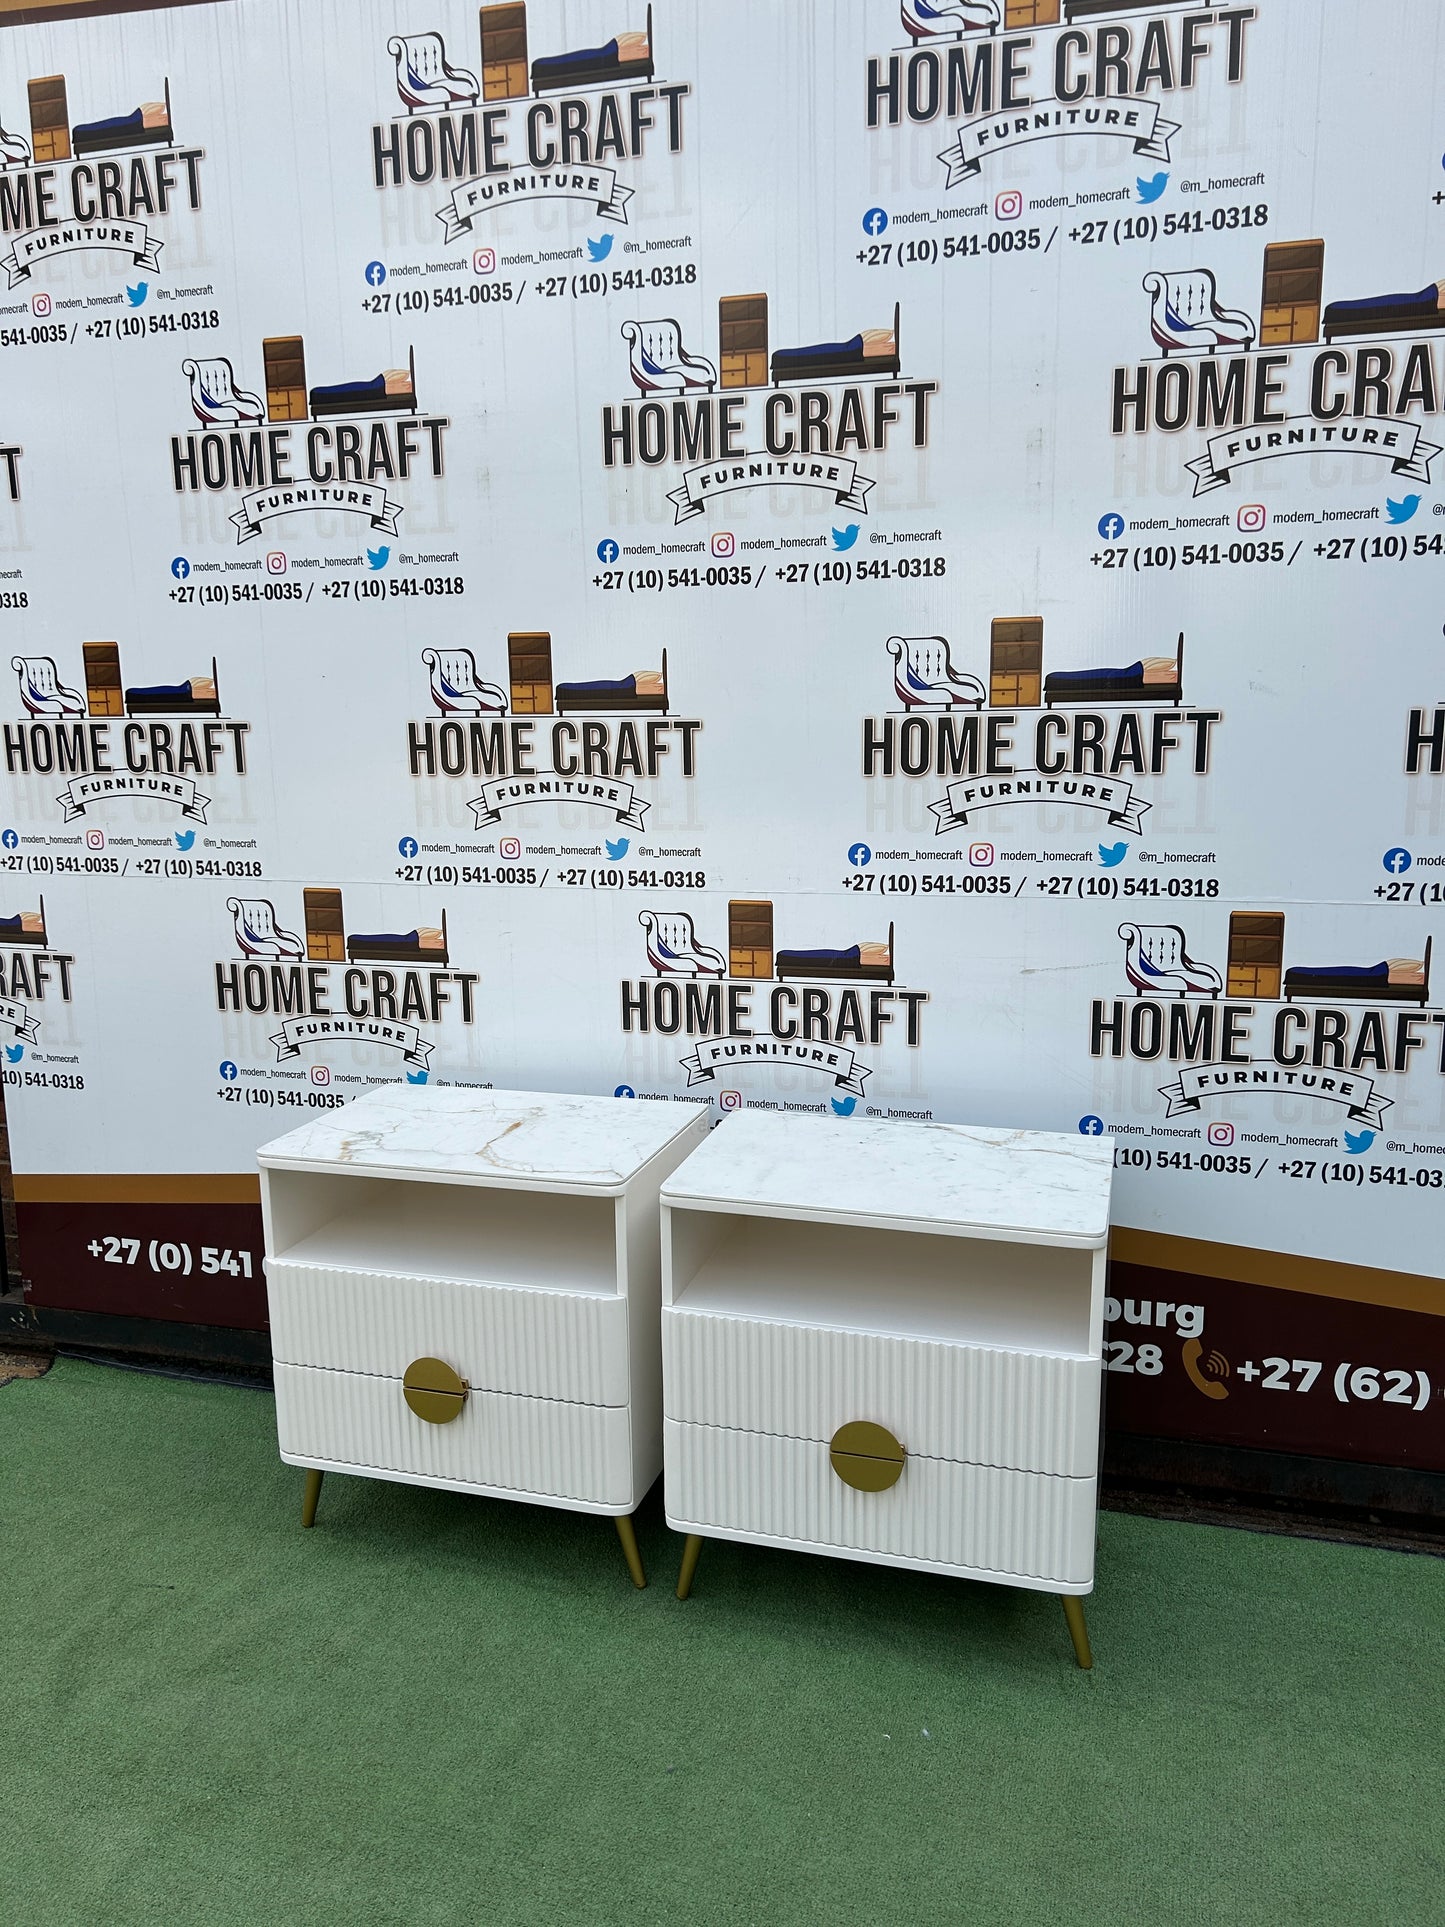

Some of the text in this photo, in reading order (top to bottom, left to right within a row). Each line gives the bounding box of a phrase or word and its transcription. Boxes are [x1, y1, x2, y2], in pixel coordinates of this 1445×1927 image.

[867, 8, 1254, 127] HOME CRAFT
[372, 85, 688, 187] HOME CRAFT
[977, 109, 1140, 147] FURNITURE
[71, 149, 203, 223] CRAFT
[466, 174, 600, 207] FURNITURE
[1180, 171, 1265, 194] @m_homecraft
[24, 228, 134, 256] FURNITURE
[623, 235, 692, 254] @m_homecraft
[857, 244, 893, 267] +27
[898, 239, 938, 268] (10)
[943, 228, 1041, 259] 541-0035
[1069, 220, 1109, 244] +27
[1113, 215, 1158, 246] (10)
[1163, 204, 1268, 236] 541-0318
[156, 284, 214, 301] @m_homecraft
[362, 293, 392, 314] +27
[396, 290, 429, 315] (10)
[433, 282, 513, 308] 541-0035
[535, 276, 567, 297] +27
[572, 272, 608, 299] (10)
[612, 264, 697, 291] 541-0318
[0, 324, 67, 347] 541-0035
[85, 319, 112, 338] +27
[115, 316, 146, 340] (10)
[149, 310, 220, 334] 541-0318
[1113, 355, 1287, 433] HOME
[603, 383, 935, 466] HOME CRAFT
[171, 418, 448, 491] HOME CRAFT
[1227, 427, 1399, 458] FURNITURE
[700, 462, 840, 490] FURNITURE
[256, 489, 373, 513] FURNITURE
[869, 529, 942, 545] @m_homecraft
[398, 551, 460, 566] @m_homecraft
[1091, 548, 1129, 568] +27
[1134, 546, 1176, 571] (10)
[1181, 541, 1284, 565] 541-0035
[1313, 538, 1356, 559] +27
[1360, 536, 1407, 562] (10)
[593, 571, 624, 590] +27
[628, 570, 663, 593] (10)
[667, 566, 751, 588] 541-0035
[775, 563, 809, 583] +27
[813, 561, 852, 586] (10)
[855, 557, 945, 580] 541-0318
[169, 586, 195, 603] +27
[199, 585, 229, 606] (10)
[232, 582, 303, 602] 541-0035
[322, 581, 350, 599] +27
[354, 580, 386, 602] (10)
[389, 577, 464, 597] 541-0318
[3, 723, 249, 773] HOME CRAFT
[407, 721, 700, 776] HOME CRAFT
[864, 712, 1219, 775] HOME CRAFT
[79, 778, 183, 797] FURNITURE
[495, 781, 619, 801] FURNITURE
[964, 780, 1114, 803] FURNITURE
[203, 838, 258, 849] @m_homecraft
[638, 846, 702, 858] @m_homecraft
[1138, 851, 1216, 864] @m_homecraft
[0, 855, 24, 871] +27
[27, 856, 54, 875] (10)
[56, 856, 119, 873] 541-0035
[136, 858, 161, 874] +27
[164, 859, 193, 879] (10)
[196, 860, 263, 877] 541-0318
[395, 865, 423, 882] +27
[427, 866, 458, 886] (10)
[462, 866, 536, 885] 541-0035
[557, 868, 587, 886] +27
[590, 869, 624, 890] (10)
[628, 870, 706, 889] 541-0318
[842, 874, 875, 891] +27
[880, 874, 917, 896] (10)
[921, 875, 1011, 894] 541-0035
[1036, 876, 1073, 895] +27
[1077, 877, 1118, 900] (10)
[1123, 877, 1219, 898] 541-0318
[1373, 881, 1415, 902] +27
[214, 962, 477, 1023] HOME CRAFT
[622, 980, 927, 1045] HOME CRAFT
[295, 1021, 406, 1043] FURNITURE
[1091, 1000, 1252, 1063] HOME
[31, 1052, 80, 1064] @m_homecraft
[710, 1043, 839, 1066] FURNITURE
[25, 1072, 85, 1090] 541-0318
[1197, 1070, 1354, 1096] FURNITURE
[217, 1087, 242, 1102] +27
[245, 1088, 274, 1108] (10)
[866, 1106, 933, 1120] @m_homecraft
[1156, 1151, 1251, 1174] 541-0035
[1278, 1160, 1317, 1179] +27
[1321, 1162, 1364, 1186] (10)
[87, 1236, 141, 1265] +27
[148, 1240, 192, 1276] (0)
[200, 1246, 253, 1278] 541
[1101, 1340, 1431, 1411] 28 +27 (62)
